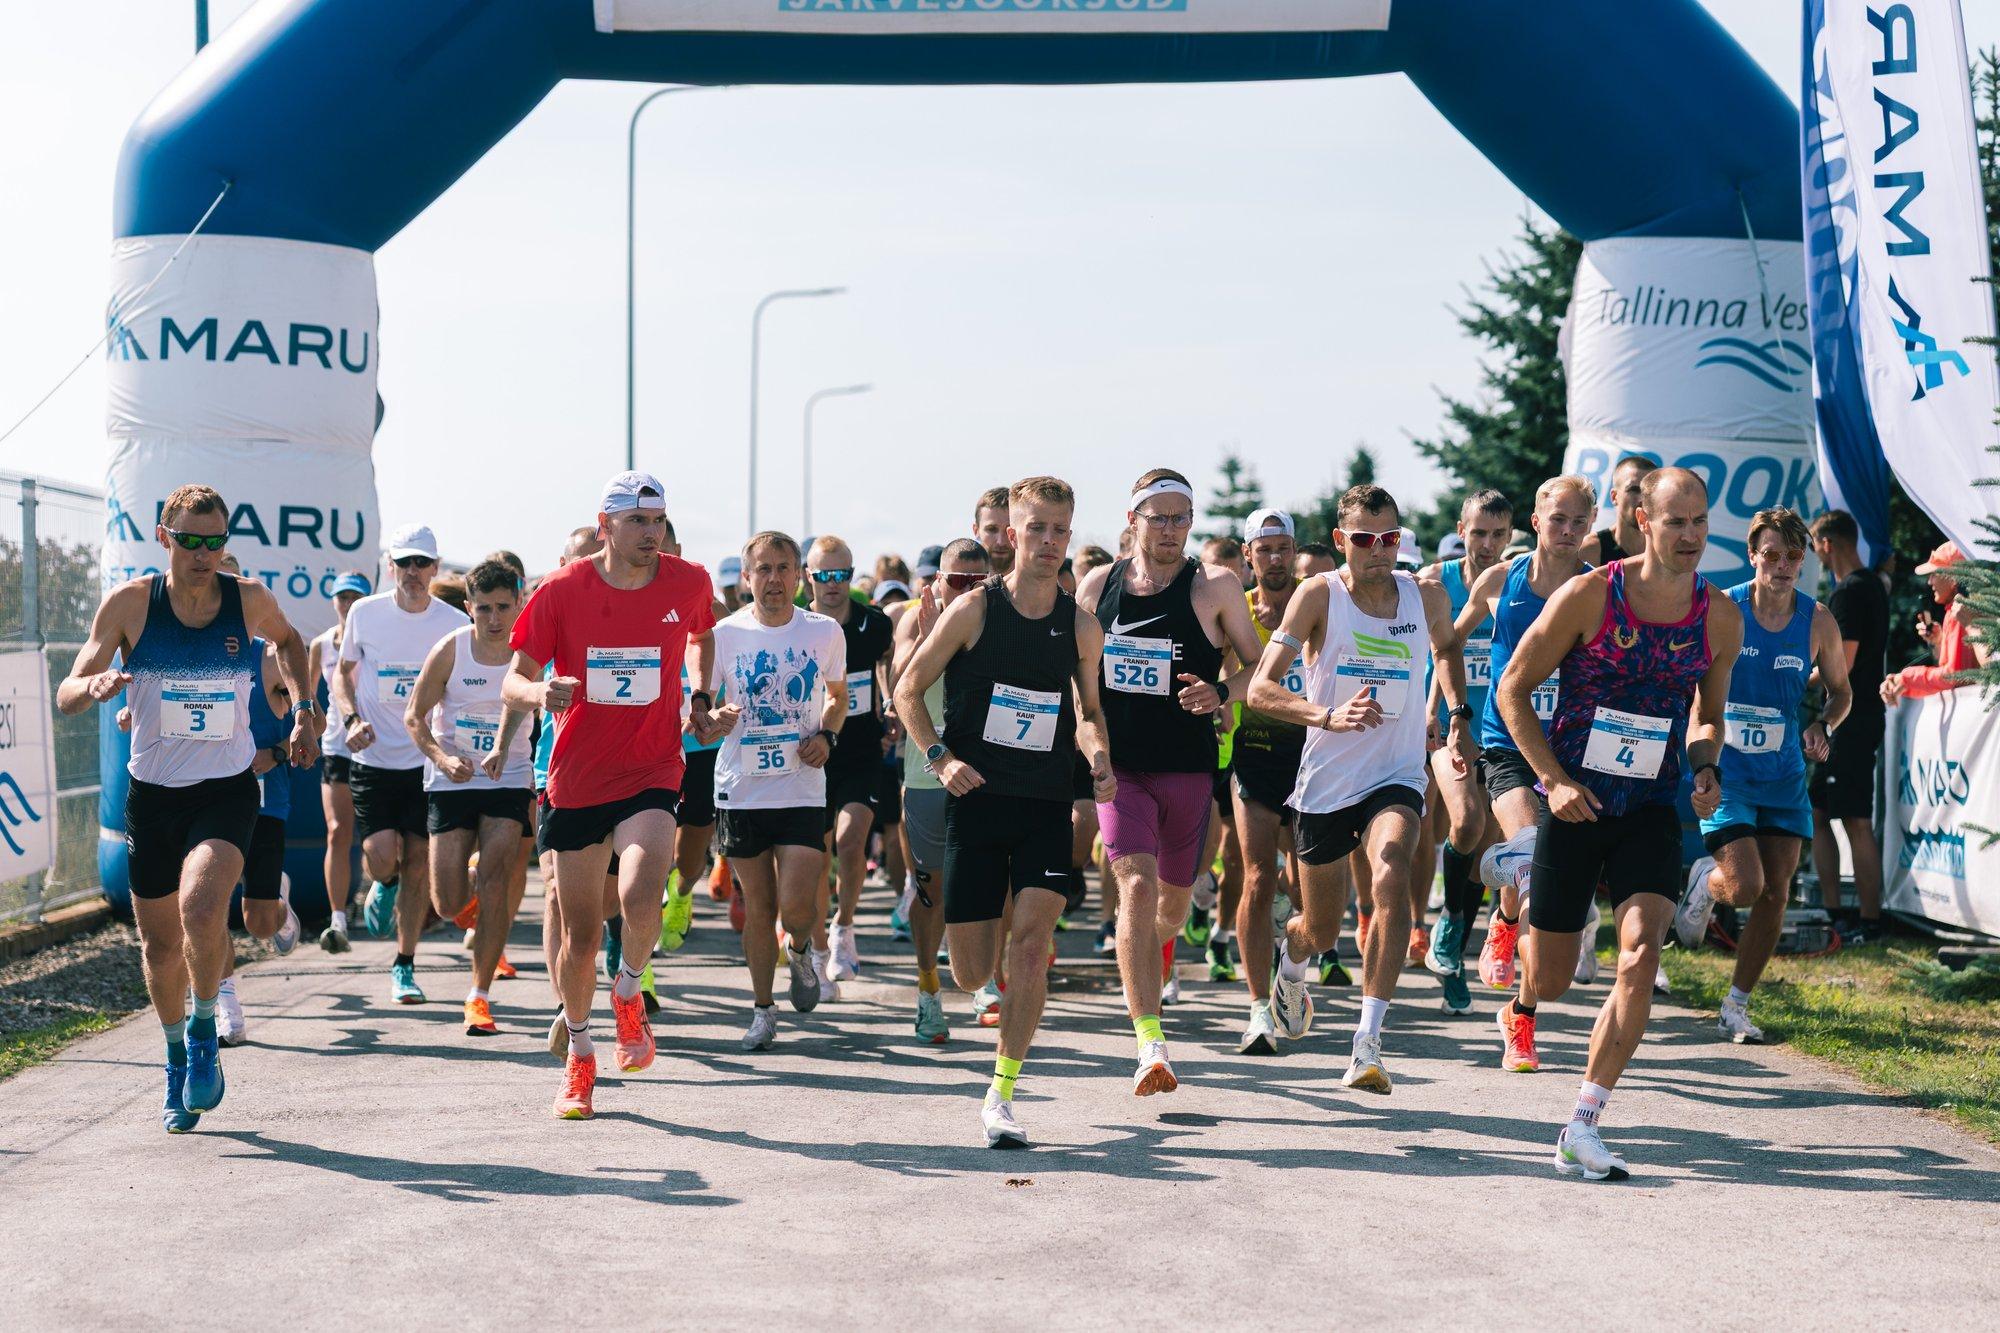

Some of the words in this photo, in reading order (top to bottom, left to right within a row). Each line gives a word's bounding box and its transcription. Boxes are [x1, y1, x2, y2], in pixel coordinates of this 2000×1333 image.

[1600, 286, 1748, 328] Tallinna
[160, 317, 368, 374] MARU
[1576, 448, 1829, 521] BOOK
[156, 501, 365, 552] ARU
[1388, 622, 1417, 636] sparta
[1114, 664, 1158, 687] 526
[1467, 663, 1491, 680] 14
[463, 678, 488, 686] sparta
[616, 677, 632, 698] 2
[753, 671, 806, 708] 20
[1279, 674, 1303, 693] 0
[1360, 678, 1387, 686] LEONID
[1532, 693, 1554, 712] 11
[190, 710, 206, 732] 3
[1016, 711, 1036, 720] KAUR
[1016, 719, 1032, 740] 7
[1740, 728, 1767, 747] 10
[472, 736, 495, 752] 18
[1620, 737, 1640, 746] BERT
[757, 750, 785, 770] 36
[1615, 746, 1634, 768] 4
